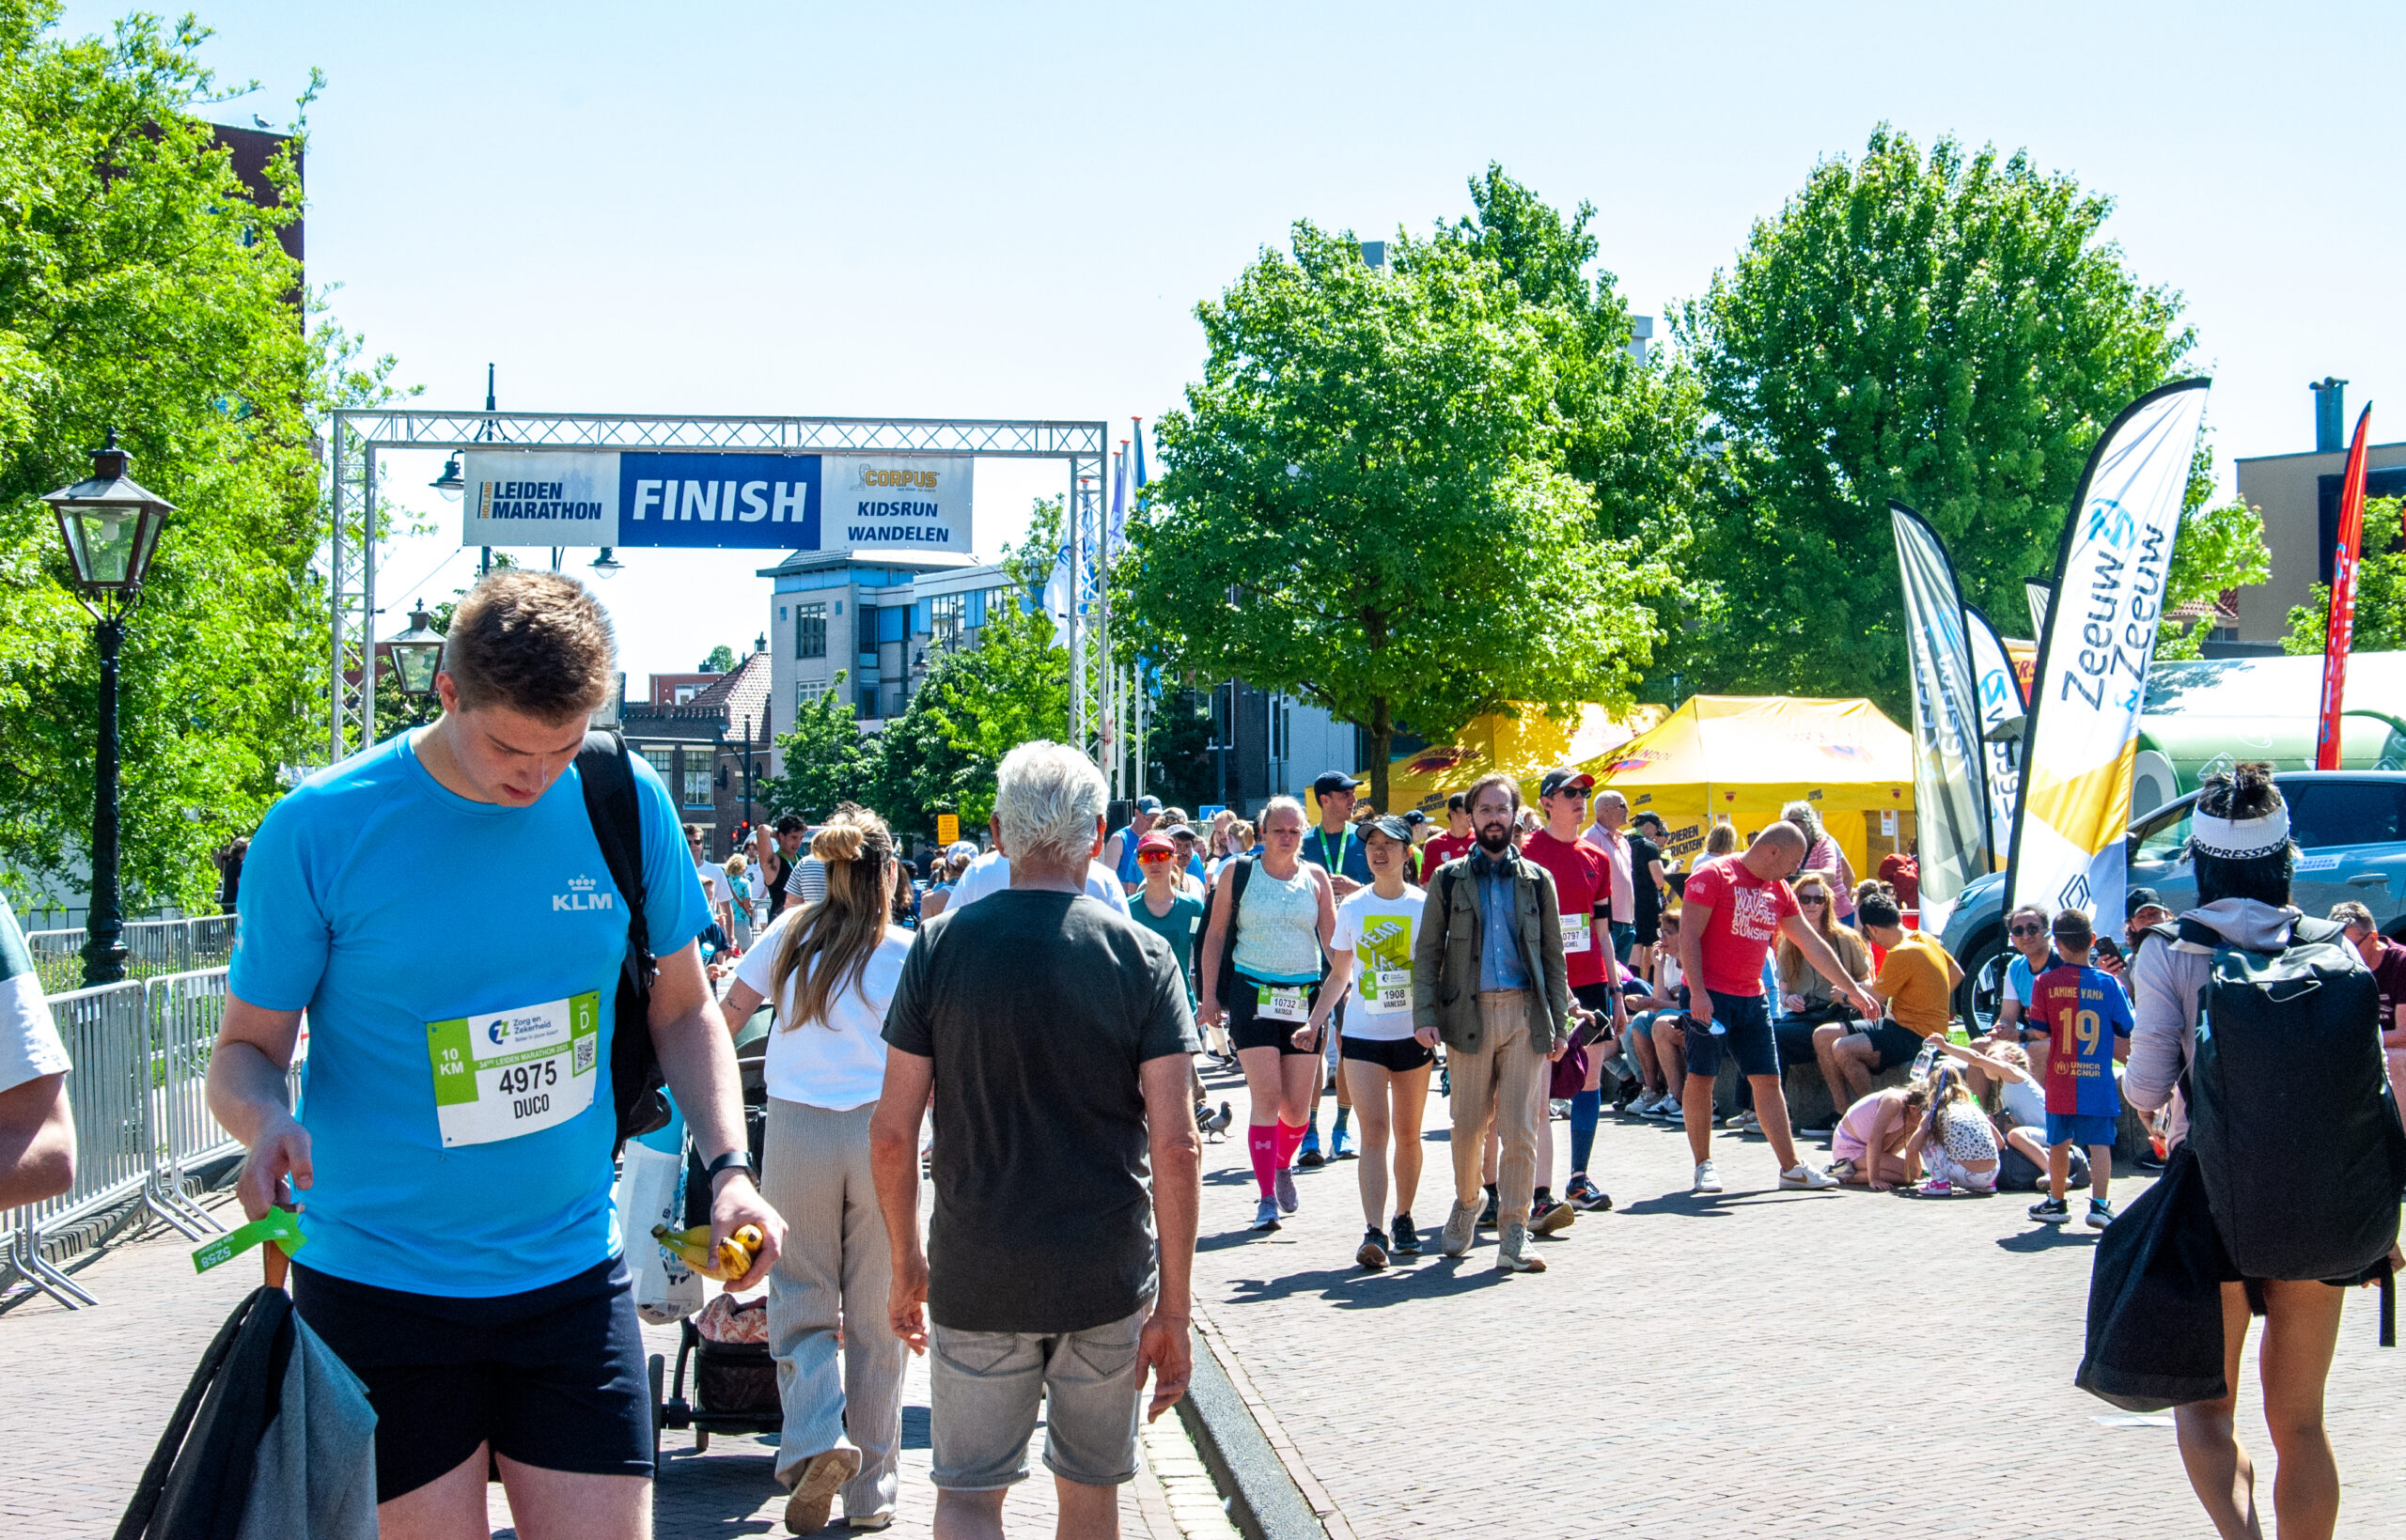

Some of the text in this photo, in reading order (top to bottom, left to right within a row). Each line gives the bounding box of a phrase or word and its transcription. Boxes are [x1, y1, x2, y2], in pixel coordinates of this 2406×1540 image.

[866, 470, 937, 488] CORPUS
[494, 481, 563, 499] LEIDEN
[481, 481, 492, 519] HOLLAND
[633, 479, 807, 522] FINISH
[492, 501, 602, 520] MARATHON
[857, 502, 938, 518] KIDSRUN
[848, 526, 949, 542] WANDELEN
[2110, 523, 2165, 682] Zeeuw
[2061, 550, 2124, 711] Zeeuw
[553, 893, 613, 911] KLM
[1356, 921, 1404, 949] FEAR
[1562, 931, 1579, 941] 0797
[1384, 989, 1405, 1000] 1908
[2049, 987, 2078, 999] LAMINE
[1274, 998, 1296, 1008] 10732
[1383, 1000, 1407, 1008] VANESSA
[513, 1018, 530, 1027] Zorg
[514, 1020, 552, 1034] Zekerheid
[580, 1011, 589, 1030] D
[2059, 1007, 2101, 1056] 19
[442, 1048, 459, 1061] 10
[495, 1055, 520, 1066] LEIDEN
[521, 1048, 555, 1061] MARATHON
[440, 1061, 464, 1076] KM
[2070, 1062, 2101, 1070] UNHCR
[2070, 1069, 2101, 1078] ACNUR
[499, 1060, 557, 1096] 4975
[513, 1094, 550, 1119] DUCO
[200, 1246, 231, 1268] 5258
